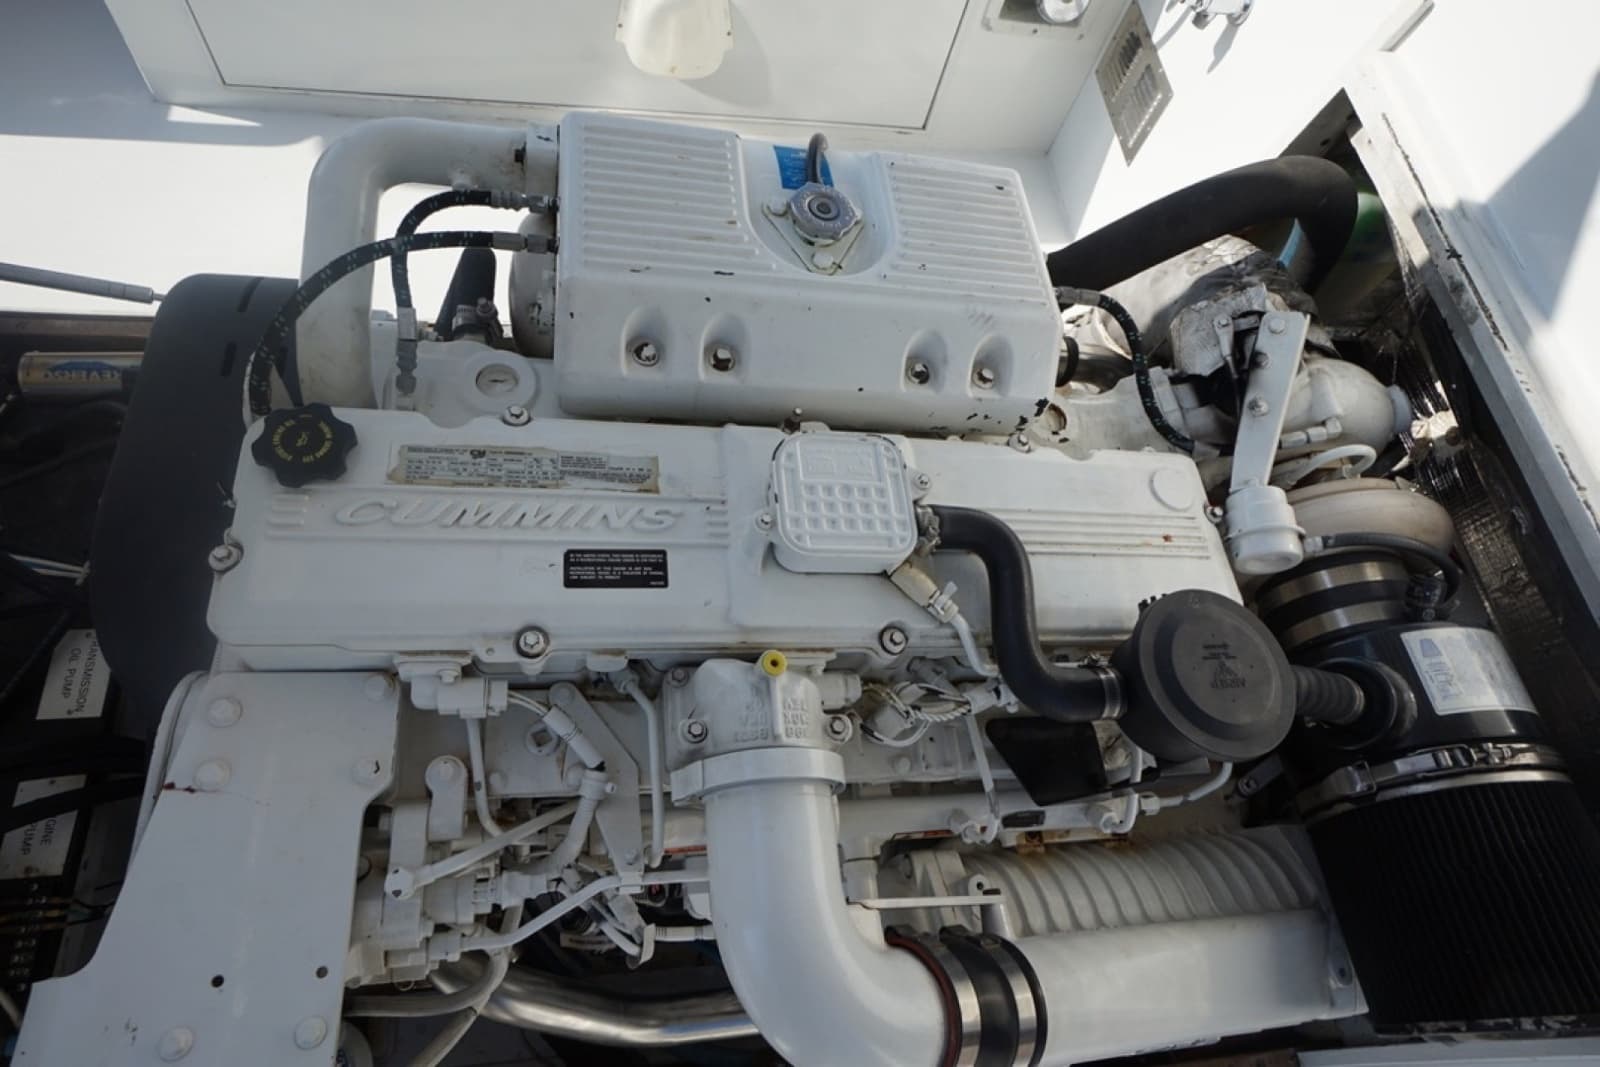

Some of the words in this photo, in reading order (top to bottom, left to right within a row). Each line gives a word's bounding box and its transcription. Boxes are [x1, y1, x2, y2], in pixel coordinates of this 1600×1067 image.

[335, 500, 682, 532] CUMMINS
[69, 647, 82, 664] OIL
[62, 667, 77, 699] PUMP
[40, 818, 57, 846] GINE
